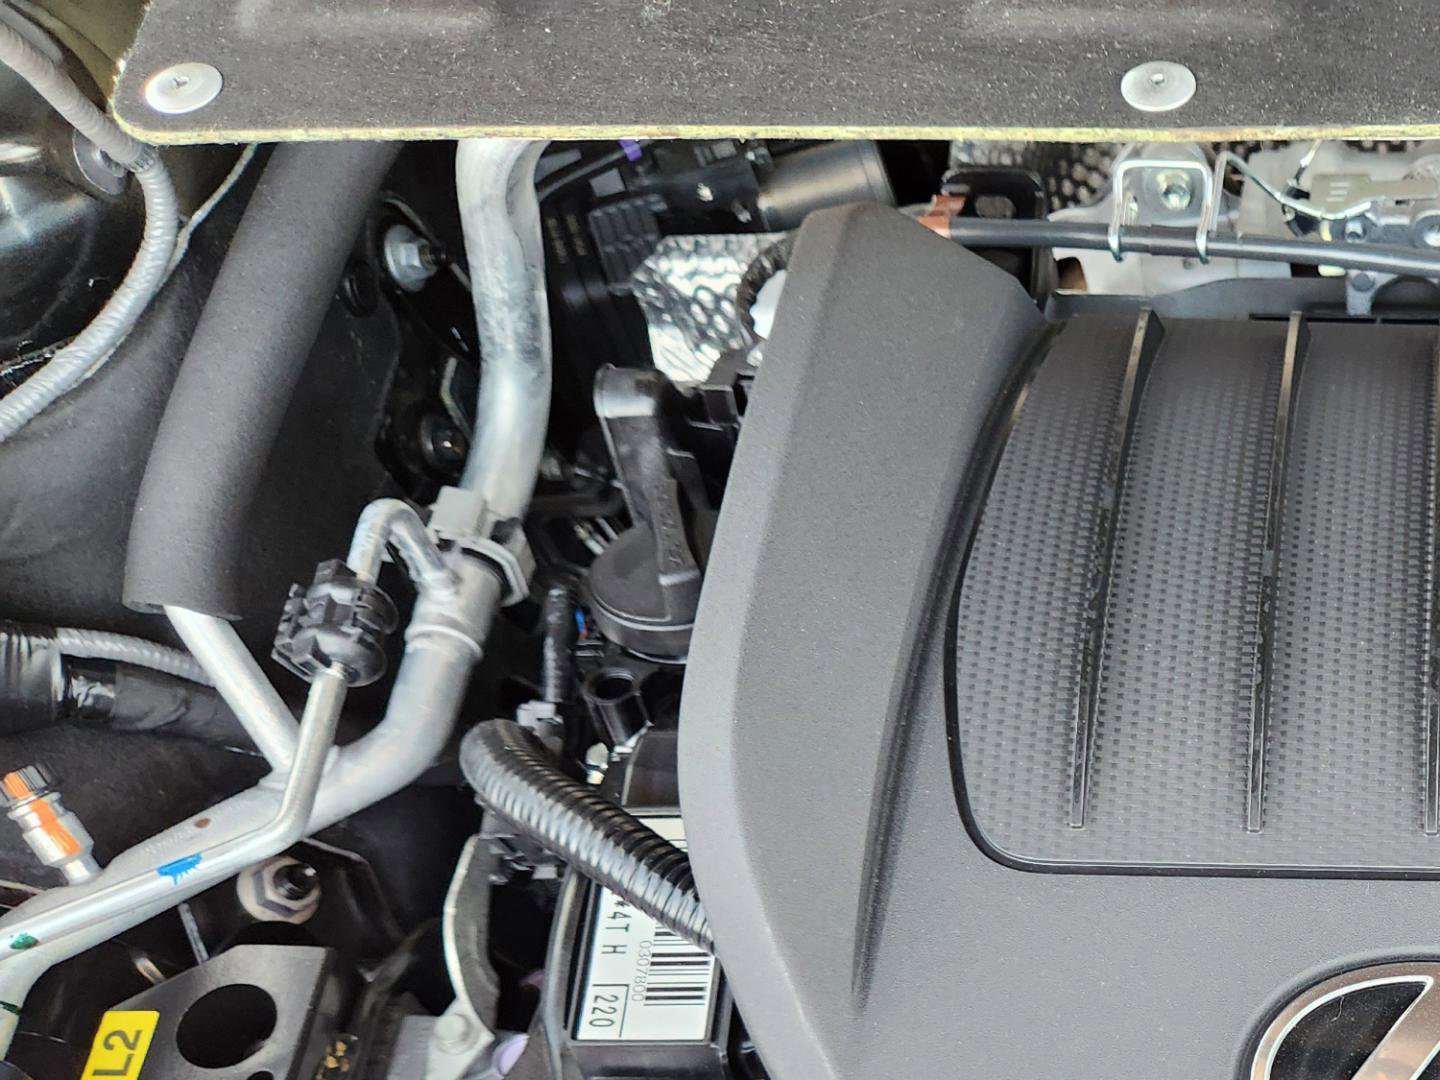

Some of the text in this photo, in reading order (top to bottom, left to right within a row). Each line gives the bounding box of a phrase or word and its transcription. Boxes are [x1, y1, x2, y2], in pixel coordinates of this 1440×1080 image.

[601, 944, 627, 955] H
[631, 940, 654, 1002] 0307800
[589, 993, 619, 1028] 220
[92, 1029, 143, 1077] L2
